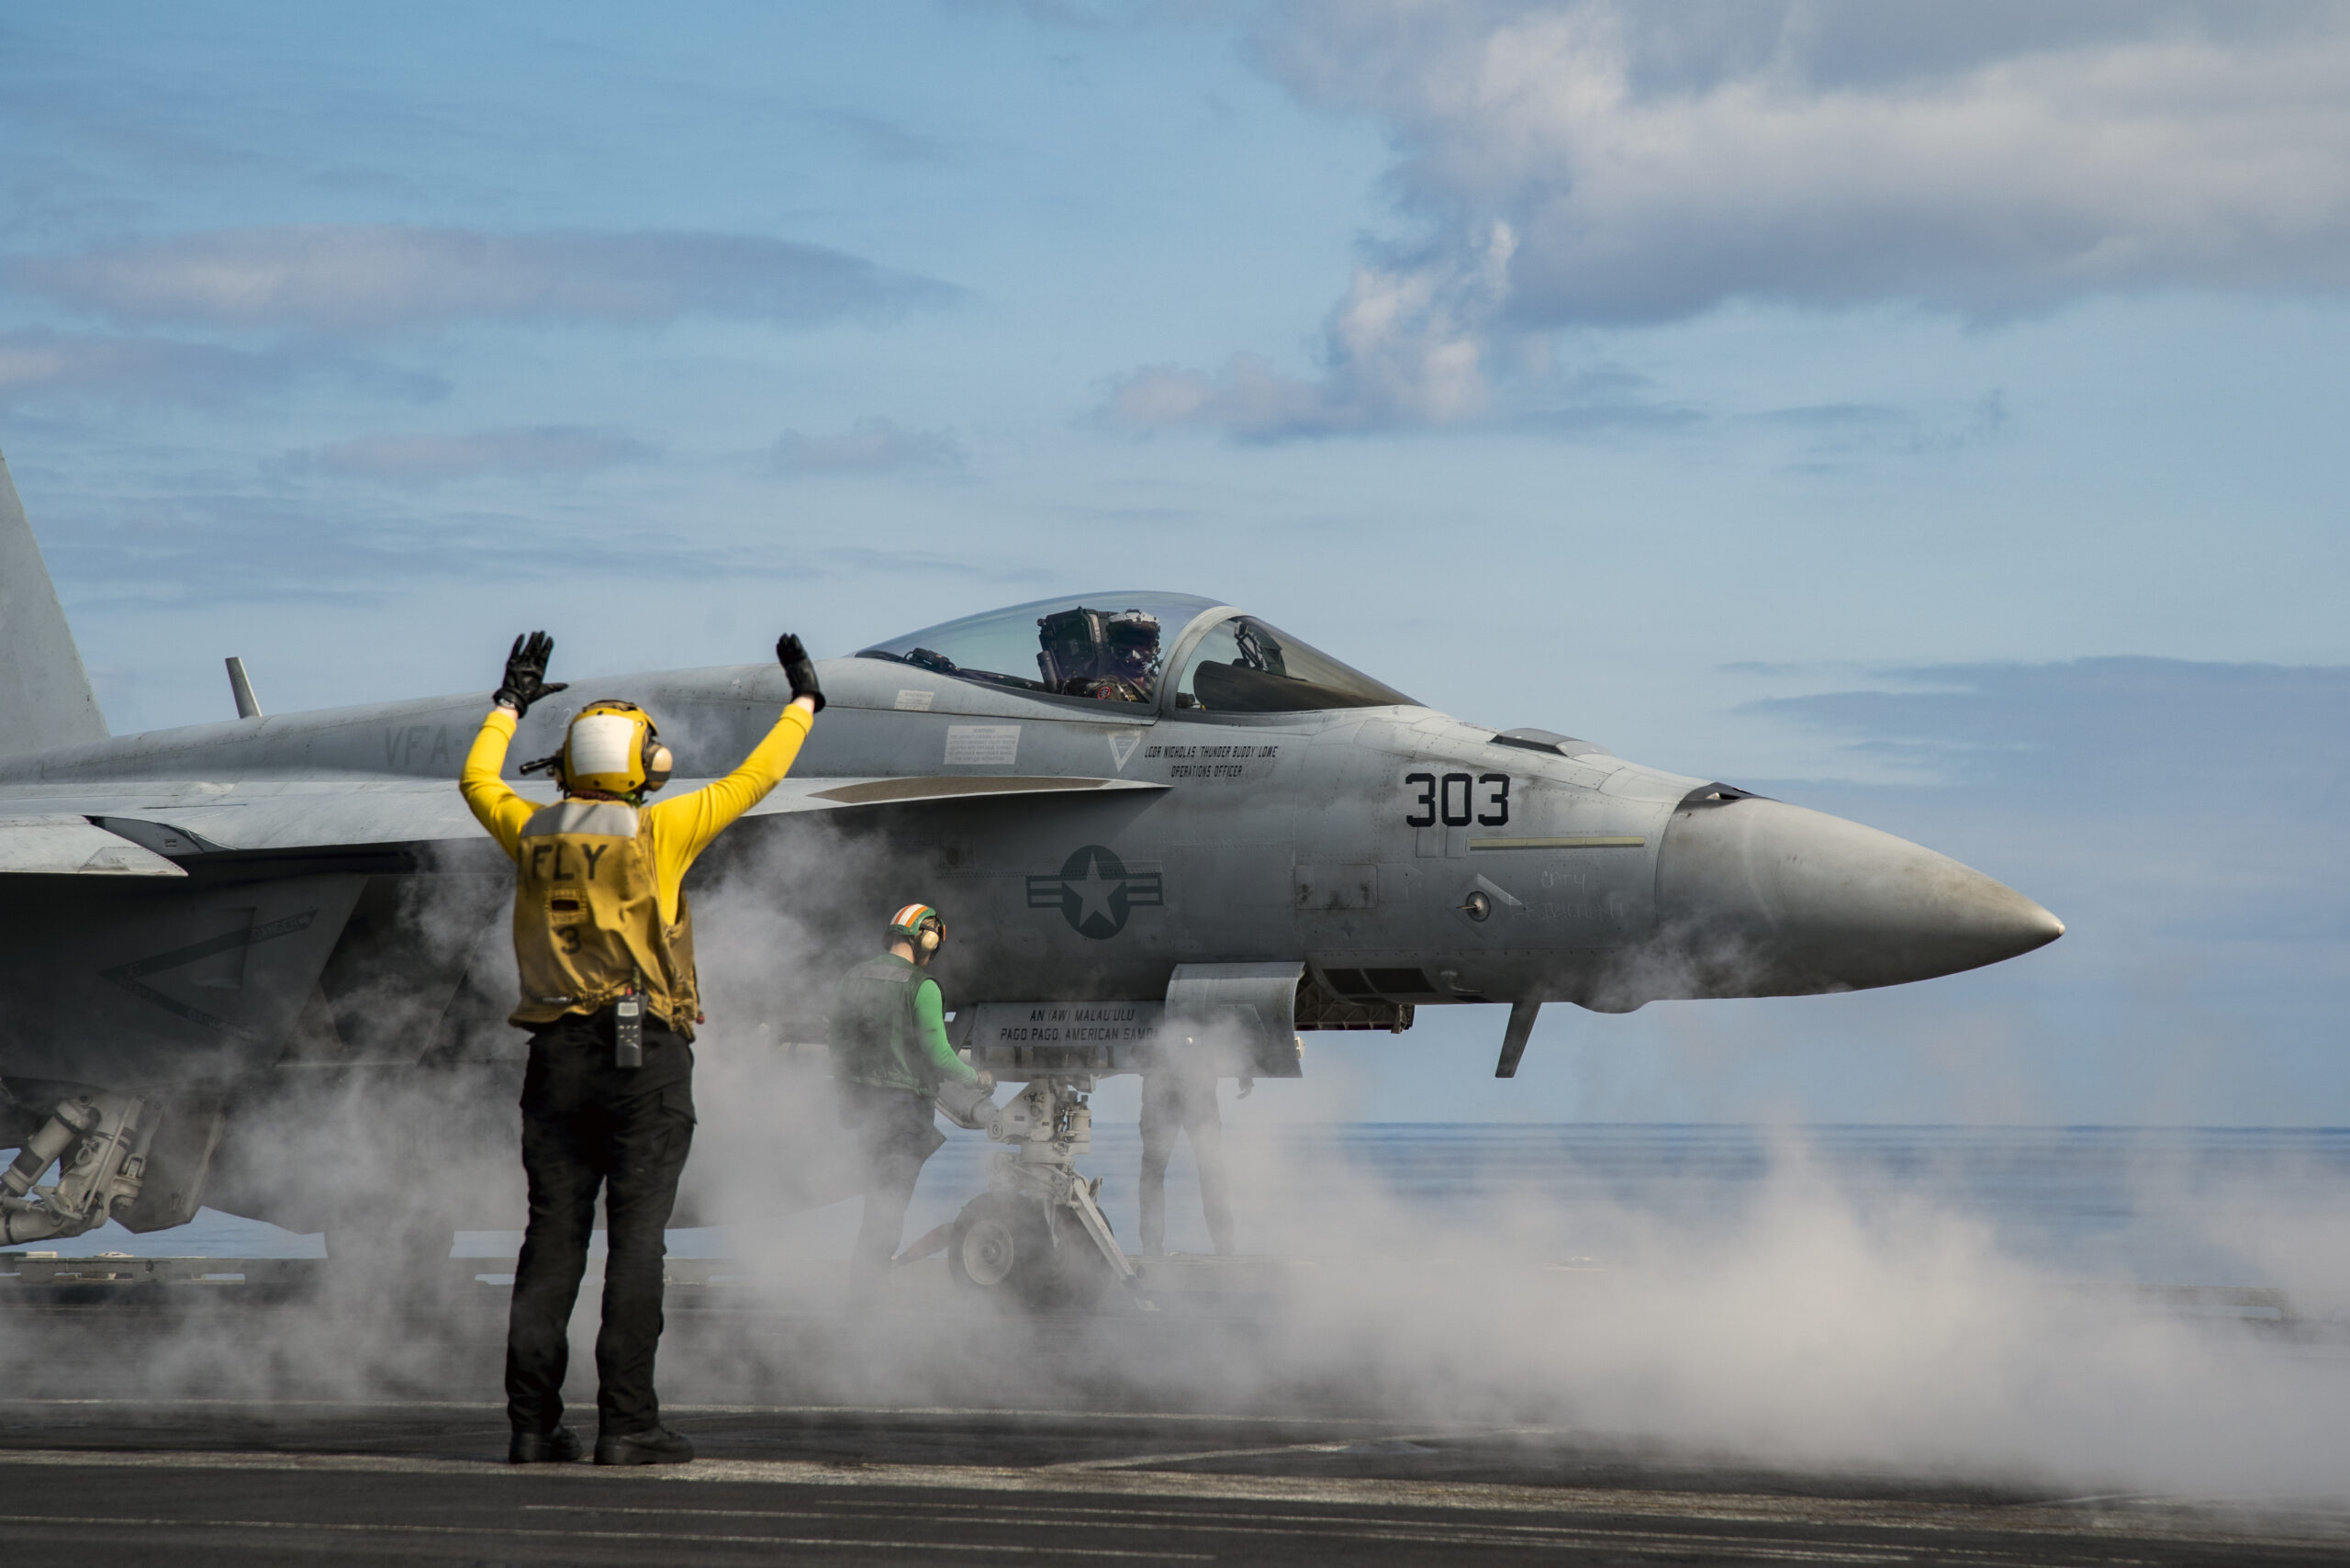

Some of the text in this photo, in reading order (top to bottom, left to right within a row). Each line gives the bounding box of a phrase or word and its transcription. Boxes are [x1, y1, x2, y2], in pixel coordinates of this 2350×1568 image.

[385, 723, 482, 767] VFA-
[1163, 745, 1197, 758] NICHOLAS
[1258, 745, 1279, 758] LOWE
[1170, 765, 1243, 778] OPERATIONS OFFICER
[1405, 772, 1511, 827] 303
[532, 843, 609, 882] FLY
[556, 924, 583, 956] 3
[1029, 1009, 1136, 1022] AN (AW) MALAU'ULU
[1000, 1028, 1027, 1041] PAGO
[1065, 1028, 1119, 1041] AMERICAN
